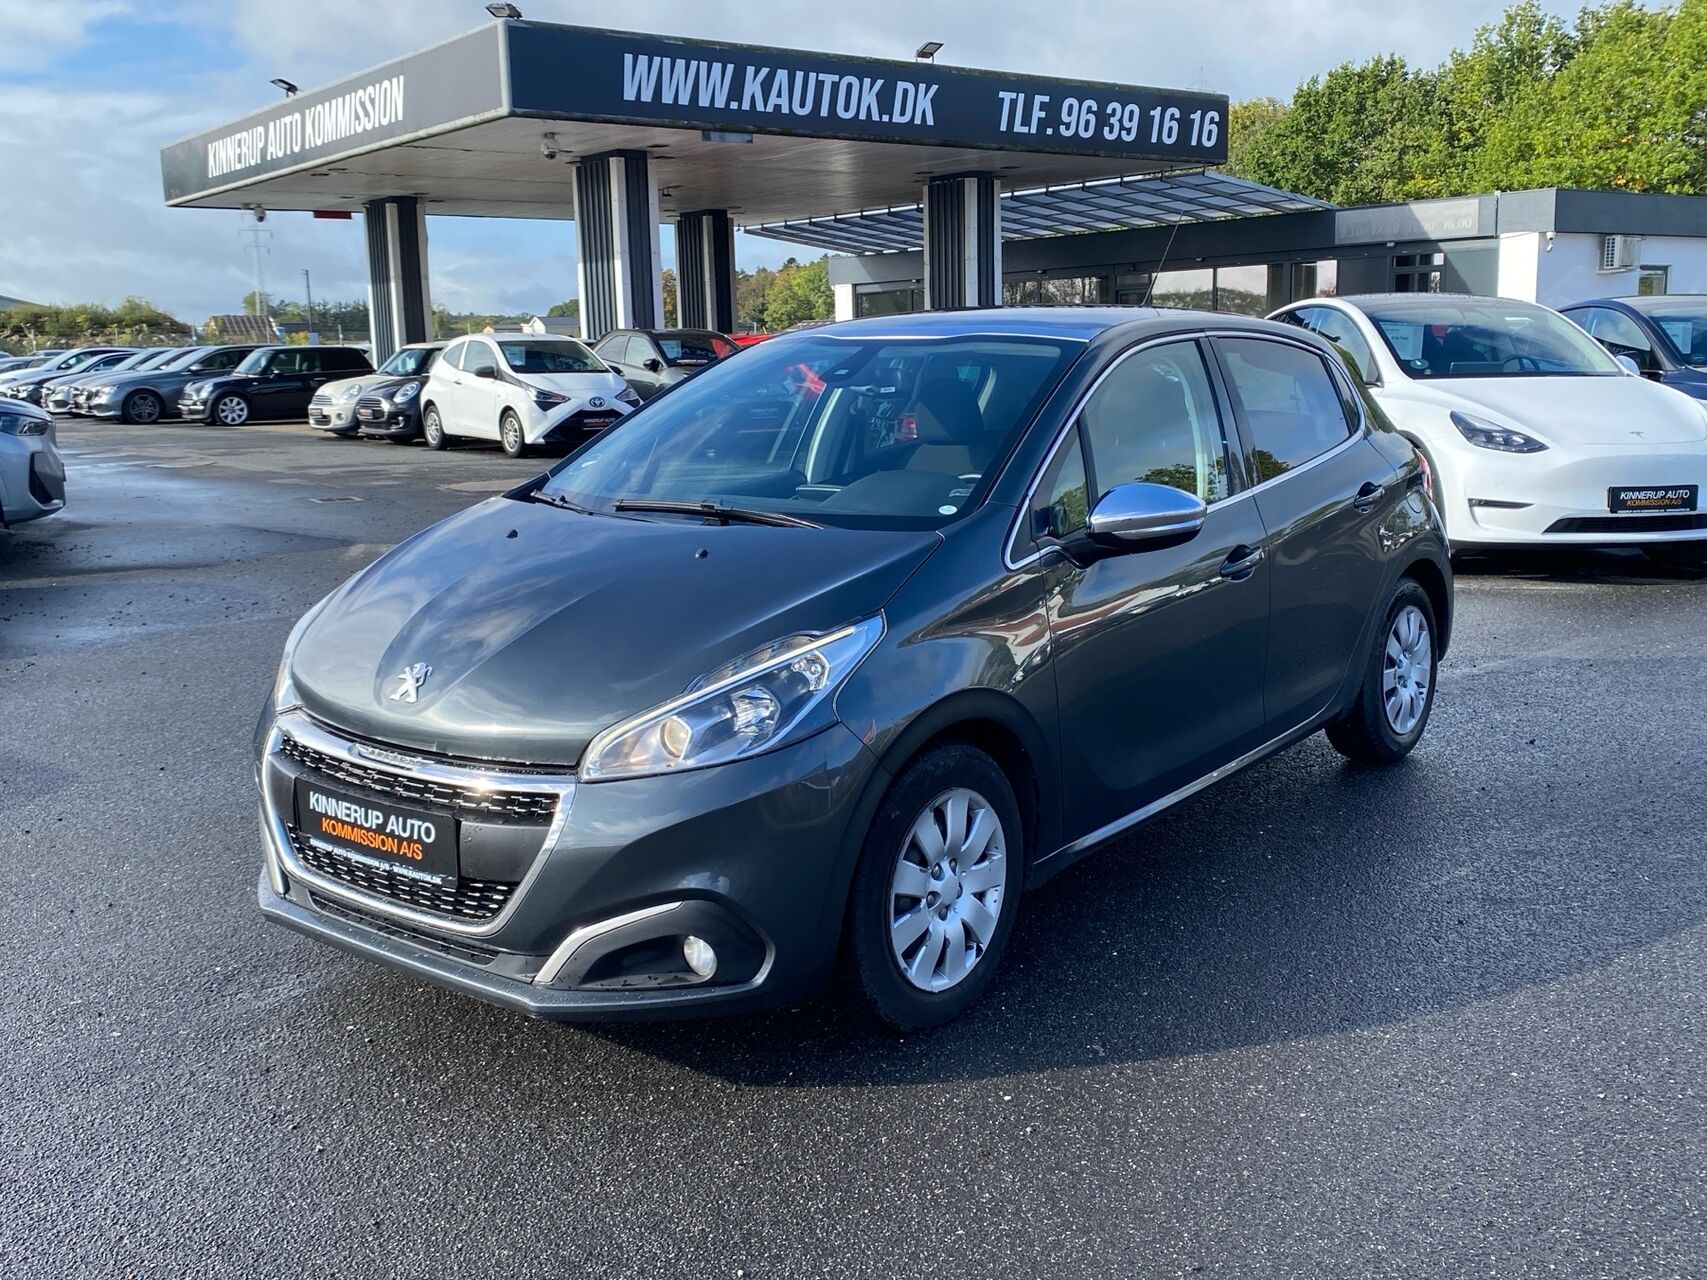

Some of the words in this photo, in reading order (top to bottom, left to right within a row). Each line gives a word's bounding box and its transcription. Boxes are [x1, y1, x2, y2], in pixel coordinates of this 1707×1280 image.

[623, 52, 938, 126] WWW.KAUTOK.DK
[208, 125, 264, 178] KINNERUP
[267, 112, 301, 160] AUTO
[305, 75, 404, 149] KOMMISSION
[999, 91, 1053, 136] TLF.
[1059, 97, 1098, 139] 96
[1103, 101, 1140, 143] 39
[1149, 106, 1180, 145] 16
[1189, 110, 1219, 149] 16
[1620, 491, 1665, 500] KINNERUP
[1665, 490, 1690, 499] AUTO
[309, 791, 384, 830] KINNERUP
[385, 816, 436, 844] AUTO
[321, 816, 398, 854] KOMMISSION
[400, 840, 423, 861] A/S
